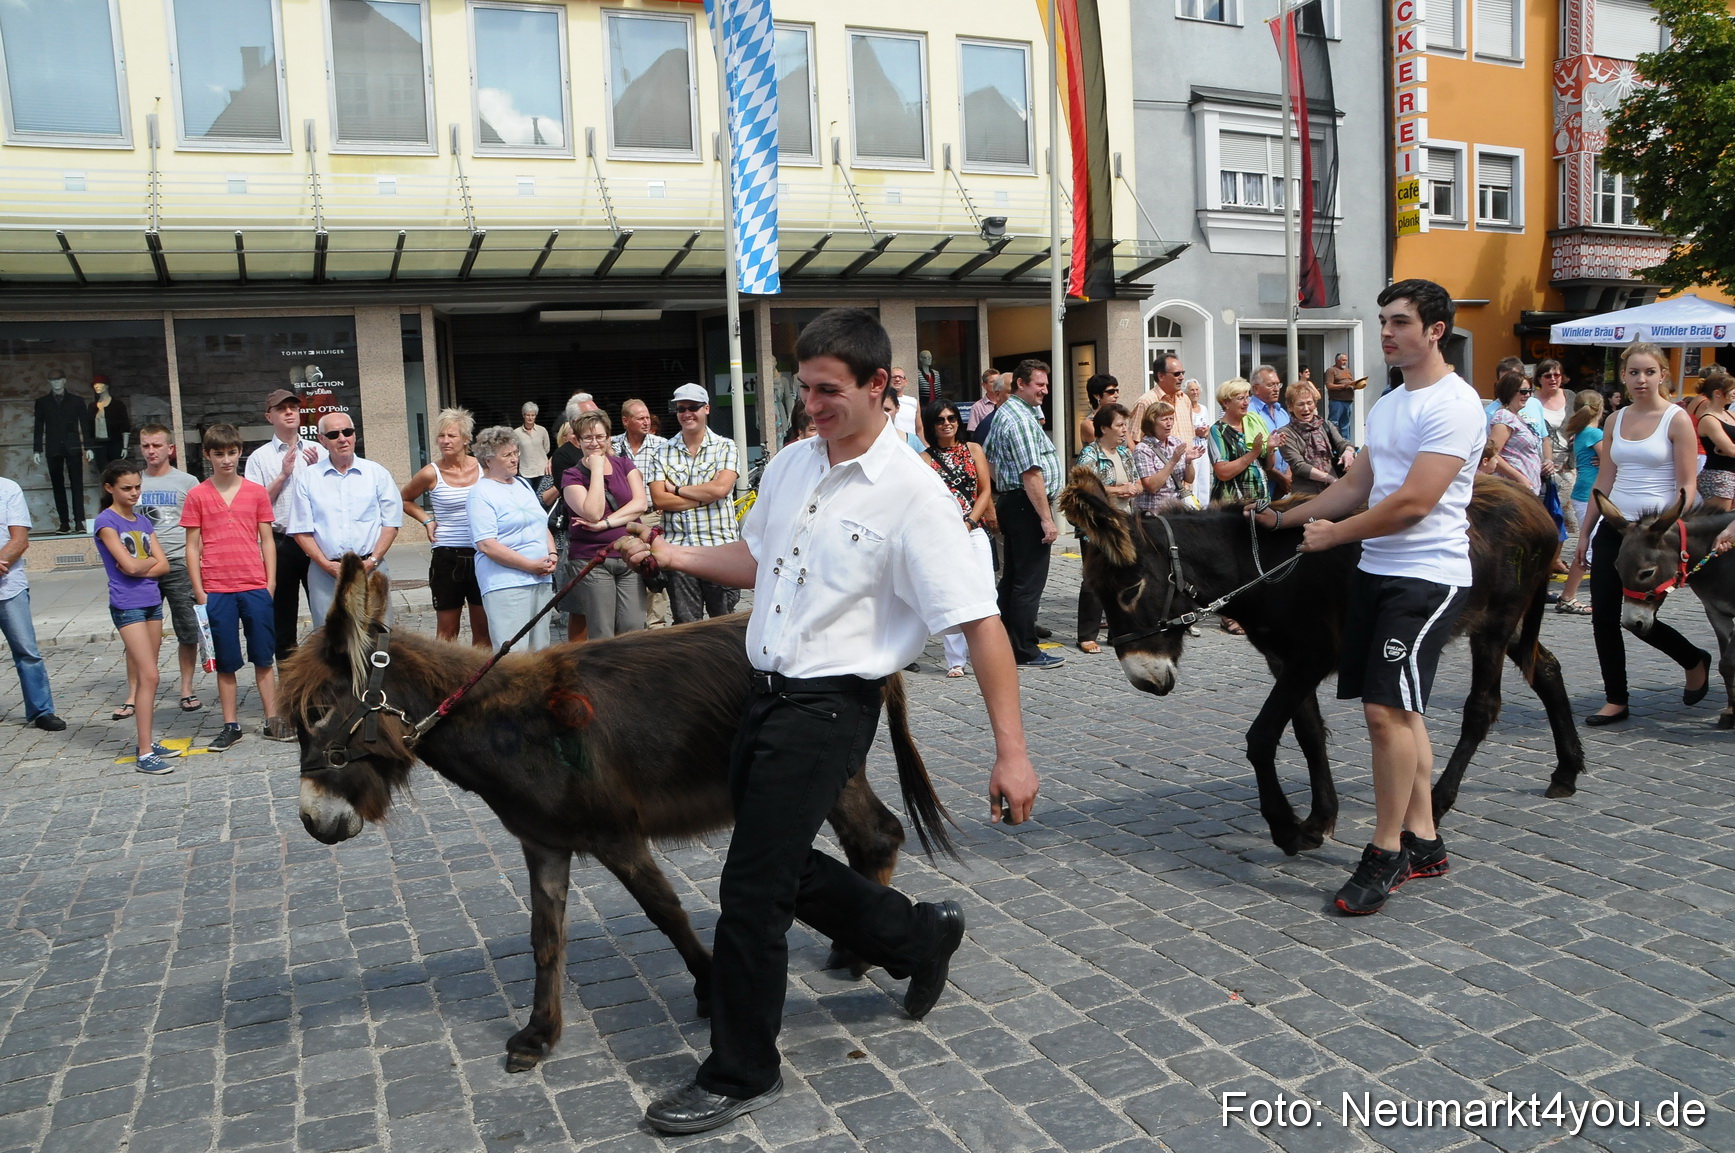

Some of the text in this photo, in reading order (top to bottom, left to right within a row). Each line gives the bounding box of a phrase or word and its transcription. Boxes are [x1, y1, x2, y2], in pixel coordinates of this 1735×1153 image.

[1397, 183, 1419, 200] café
[1398, 212, 1420, 230] plank
[1119, 319, 1129, 328] 47
[1561, 326, 1614, 337] Winkler Bräu
[1651, 325, 1712, 336] Winkler Bräu
[318, 405, 349, 413] O'Polo
